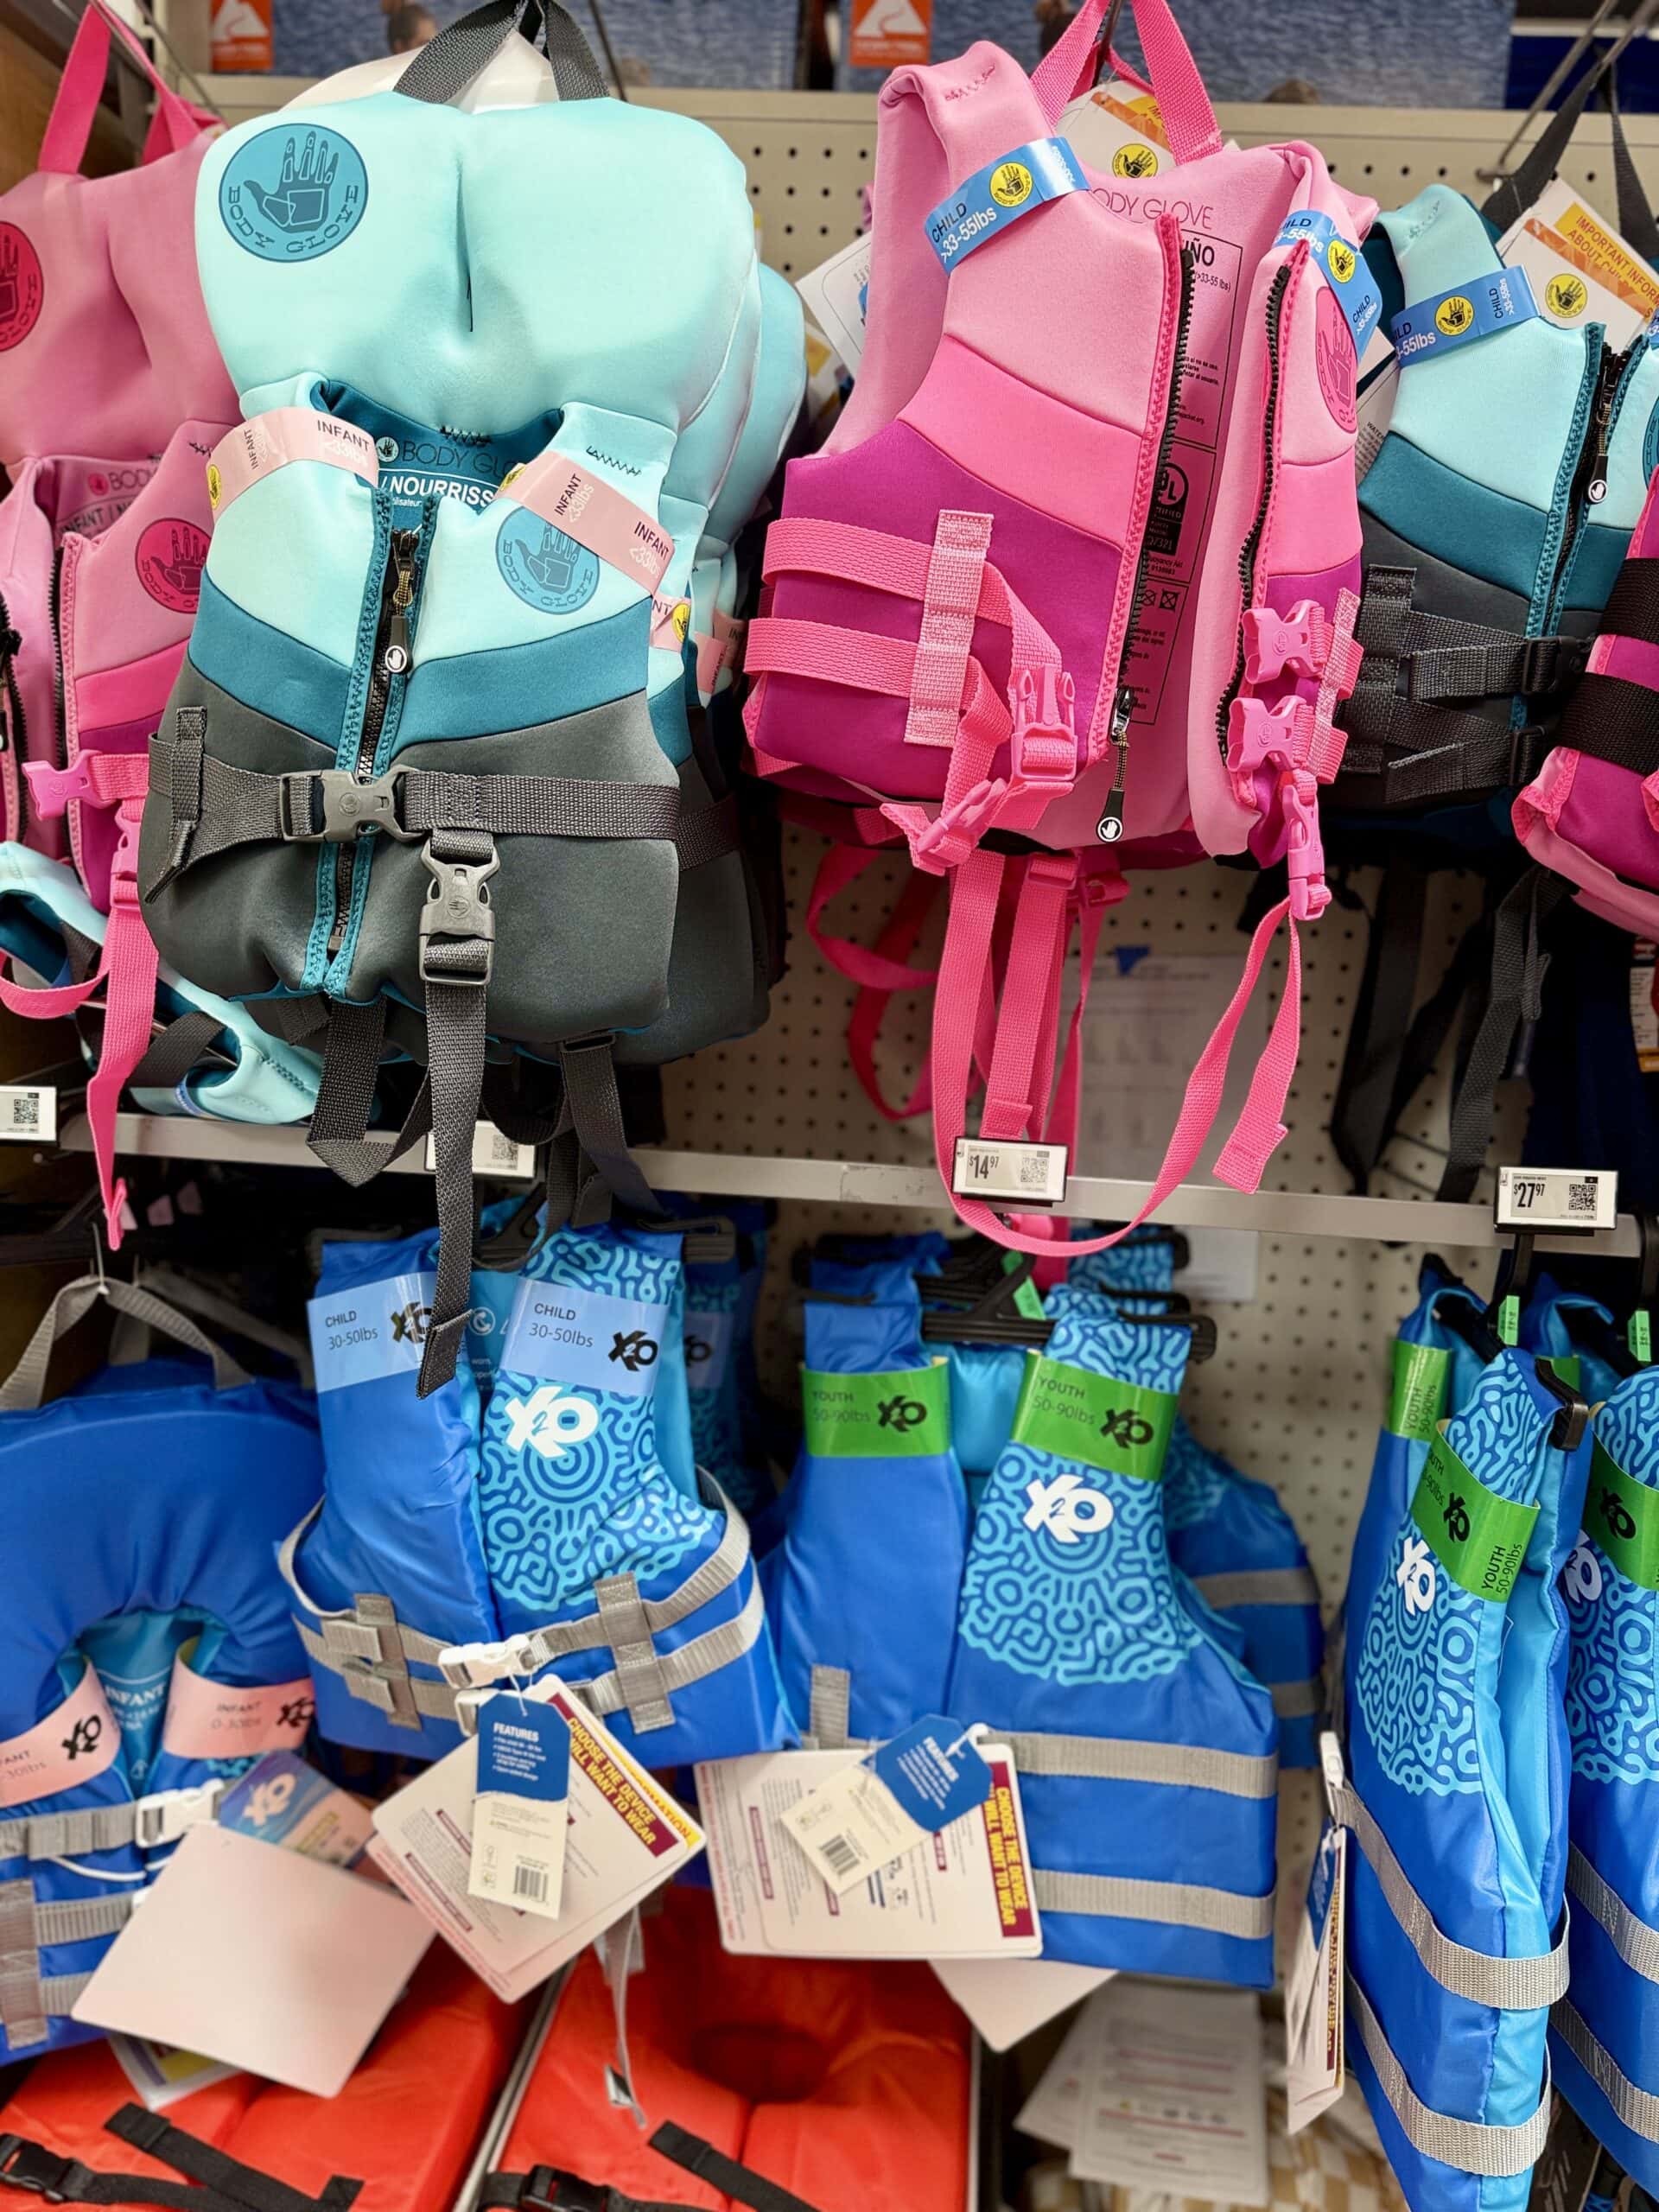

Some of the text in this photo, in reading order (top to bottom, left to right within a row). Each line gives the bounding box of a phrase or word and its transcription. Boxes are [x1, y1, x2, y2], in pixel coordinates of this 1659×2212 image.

[228, 185, 359, 253] BODY GLOVE
[1092, 188, 1139, 216] ODY
[931, 202, 968, 244] CHILD
[940, 207, 997, 263] >33-55lbs
[1575, 215, 1630, 274] IMPORTANT
[1351, 295, 1371, 324] CHILD
[1489, 288, 1503, 319] CHILD
[1396, 332, 1436, 360] -55lbs
[244, 428, 259, 470] INFANT
[316, 419, 371, 452] INFANT
[403, 440, 470, 468] BODY
[108, 468, 153, 491] BOD
[554, 474, 582, 516] INFANT
[569, 483, 594, 524] <33lbs
[633, 520, 671, 561] INFANT
[502, 538, 594, 608] BODY GLOVE
[325, 1310, 358, 1328] CHILD
[534, 1303, 577, 1322] CHILD
[327, 1327, 378, 1351] 30-50lbs
[529, 1321, 594, 1349] 30-50lbs
[812, 1390, 855, 1403] YOUTH
[1039, 1377, 1086, 1400] YOUTH
[813, 1407, 872, 1423] 50-90lbs
[1033, 1395, 1096, 1427] 50-90lbs
[1403, 1386, 1423, 1430] YOUTH
[1481, 1545, 1506, 1591] YOUTH
[1497, 1542, 1523, 1595] 50-90lbs
[493, 1721, 539, 1743] FEATURES
[567, 1717, 658, 1824] CHOOSE THE DEVICE
[585, 1762, 618, 1796] WANT
[613, 1792, 630, 1813] TO
[624, 1809, 658, 1846] WEAR
[988, 1831, 1007, 1869] WANT
[995, 1786, 1028, 1910] CHOOSE THE DEVICE
[995, 1869, 1010, 1888] TO
[997, 1887, 1017, 1927] WEAR
